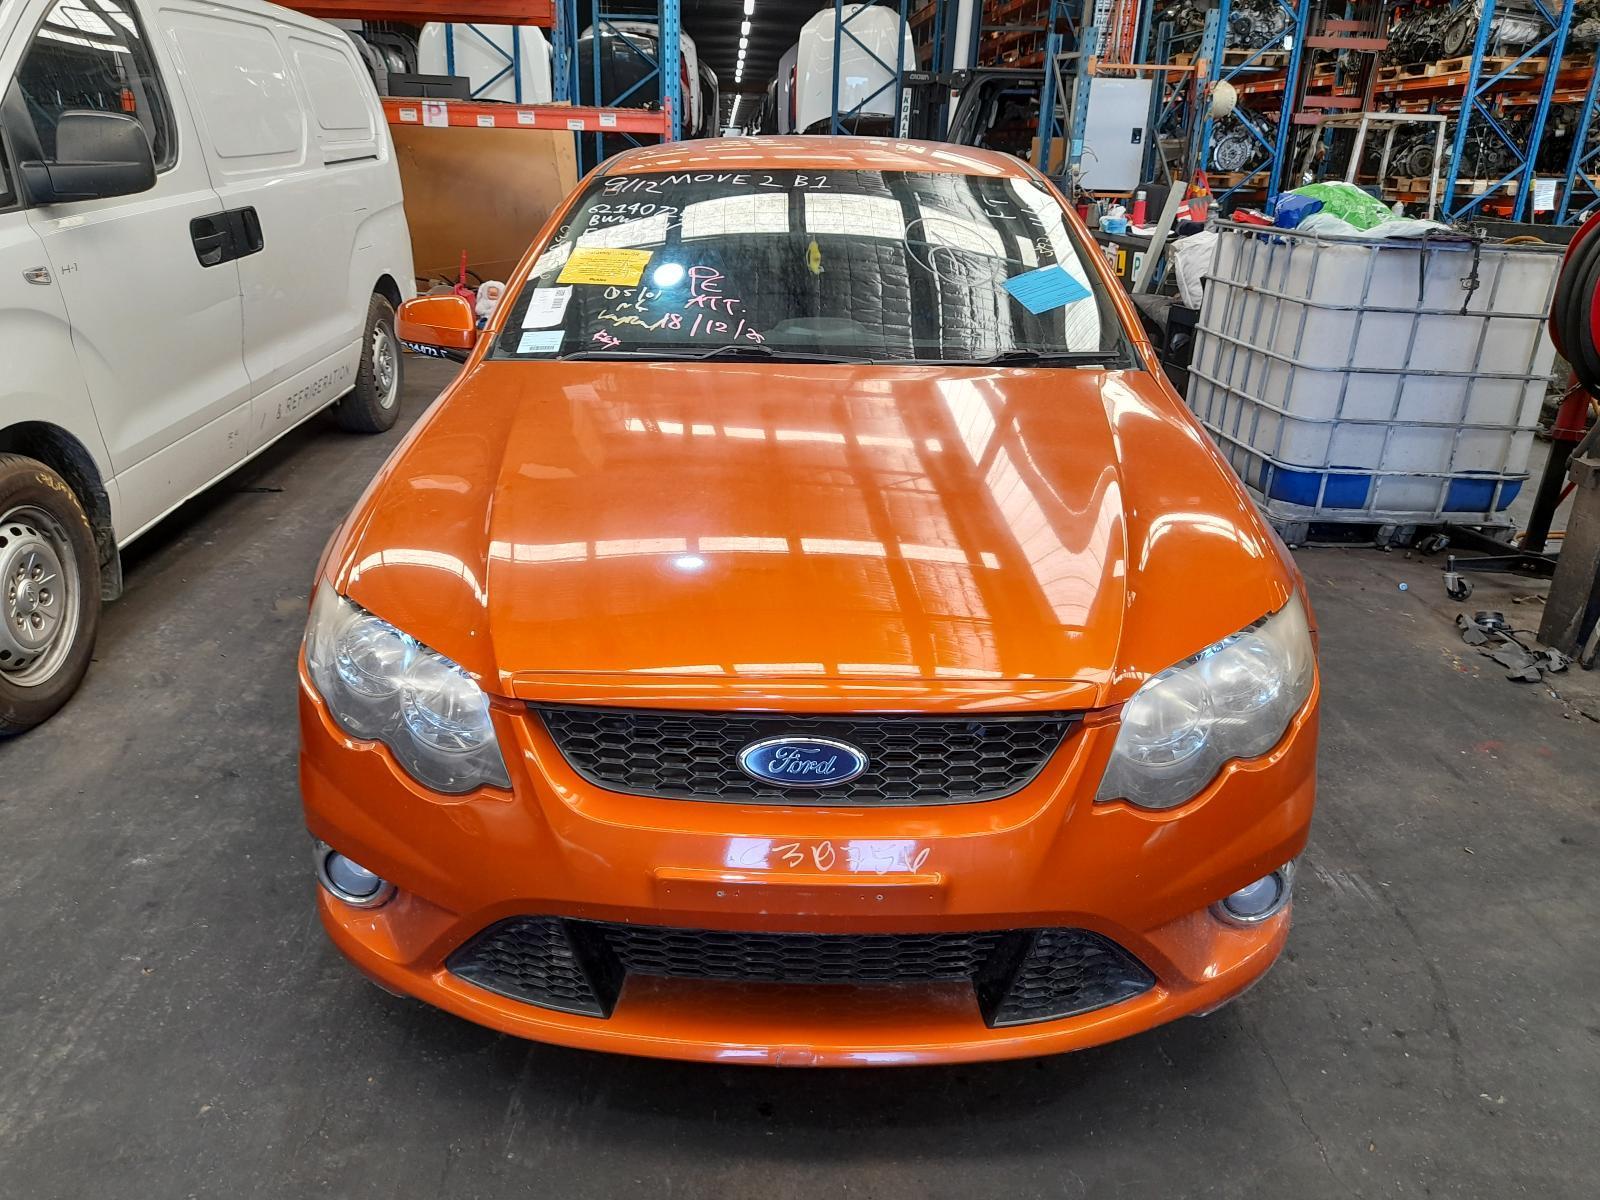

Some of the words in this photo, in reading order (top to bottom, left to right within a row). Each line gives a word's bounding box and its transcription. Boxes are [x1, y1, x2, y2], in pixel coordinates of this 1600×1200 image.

[900, 96, 910, 138] KOALA
[659, 173, 751, 186] MOVE
[758, 175, 783, 188] 2
[792, 174, 832, 189] B1
[768, 746, 838, 775] Ford
